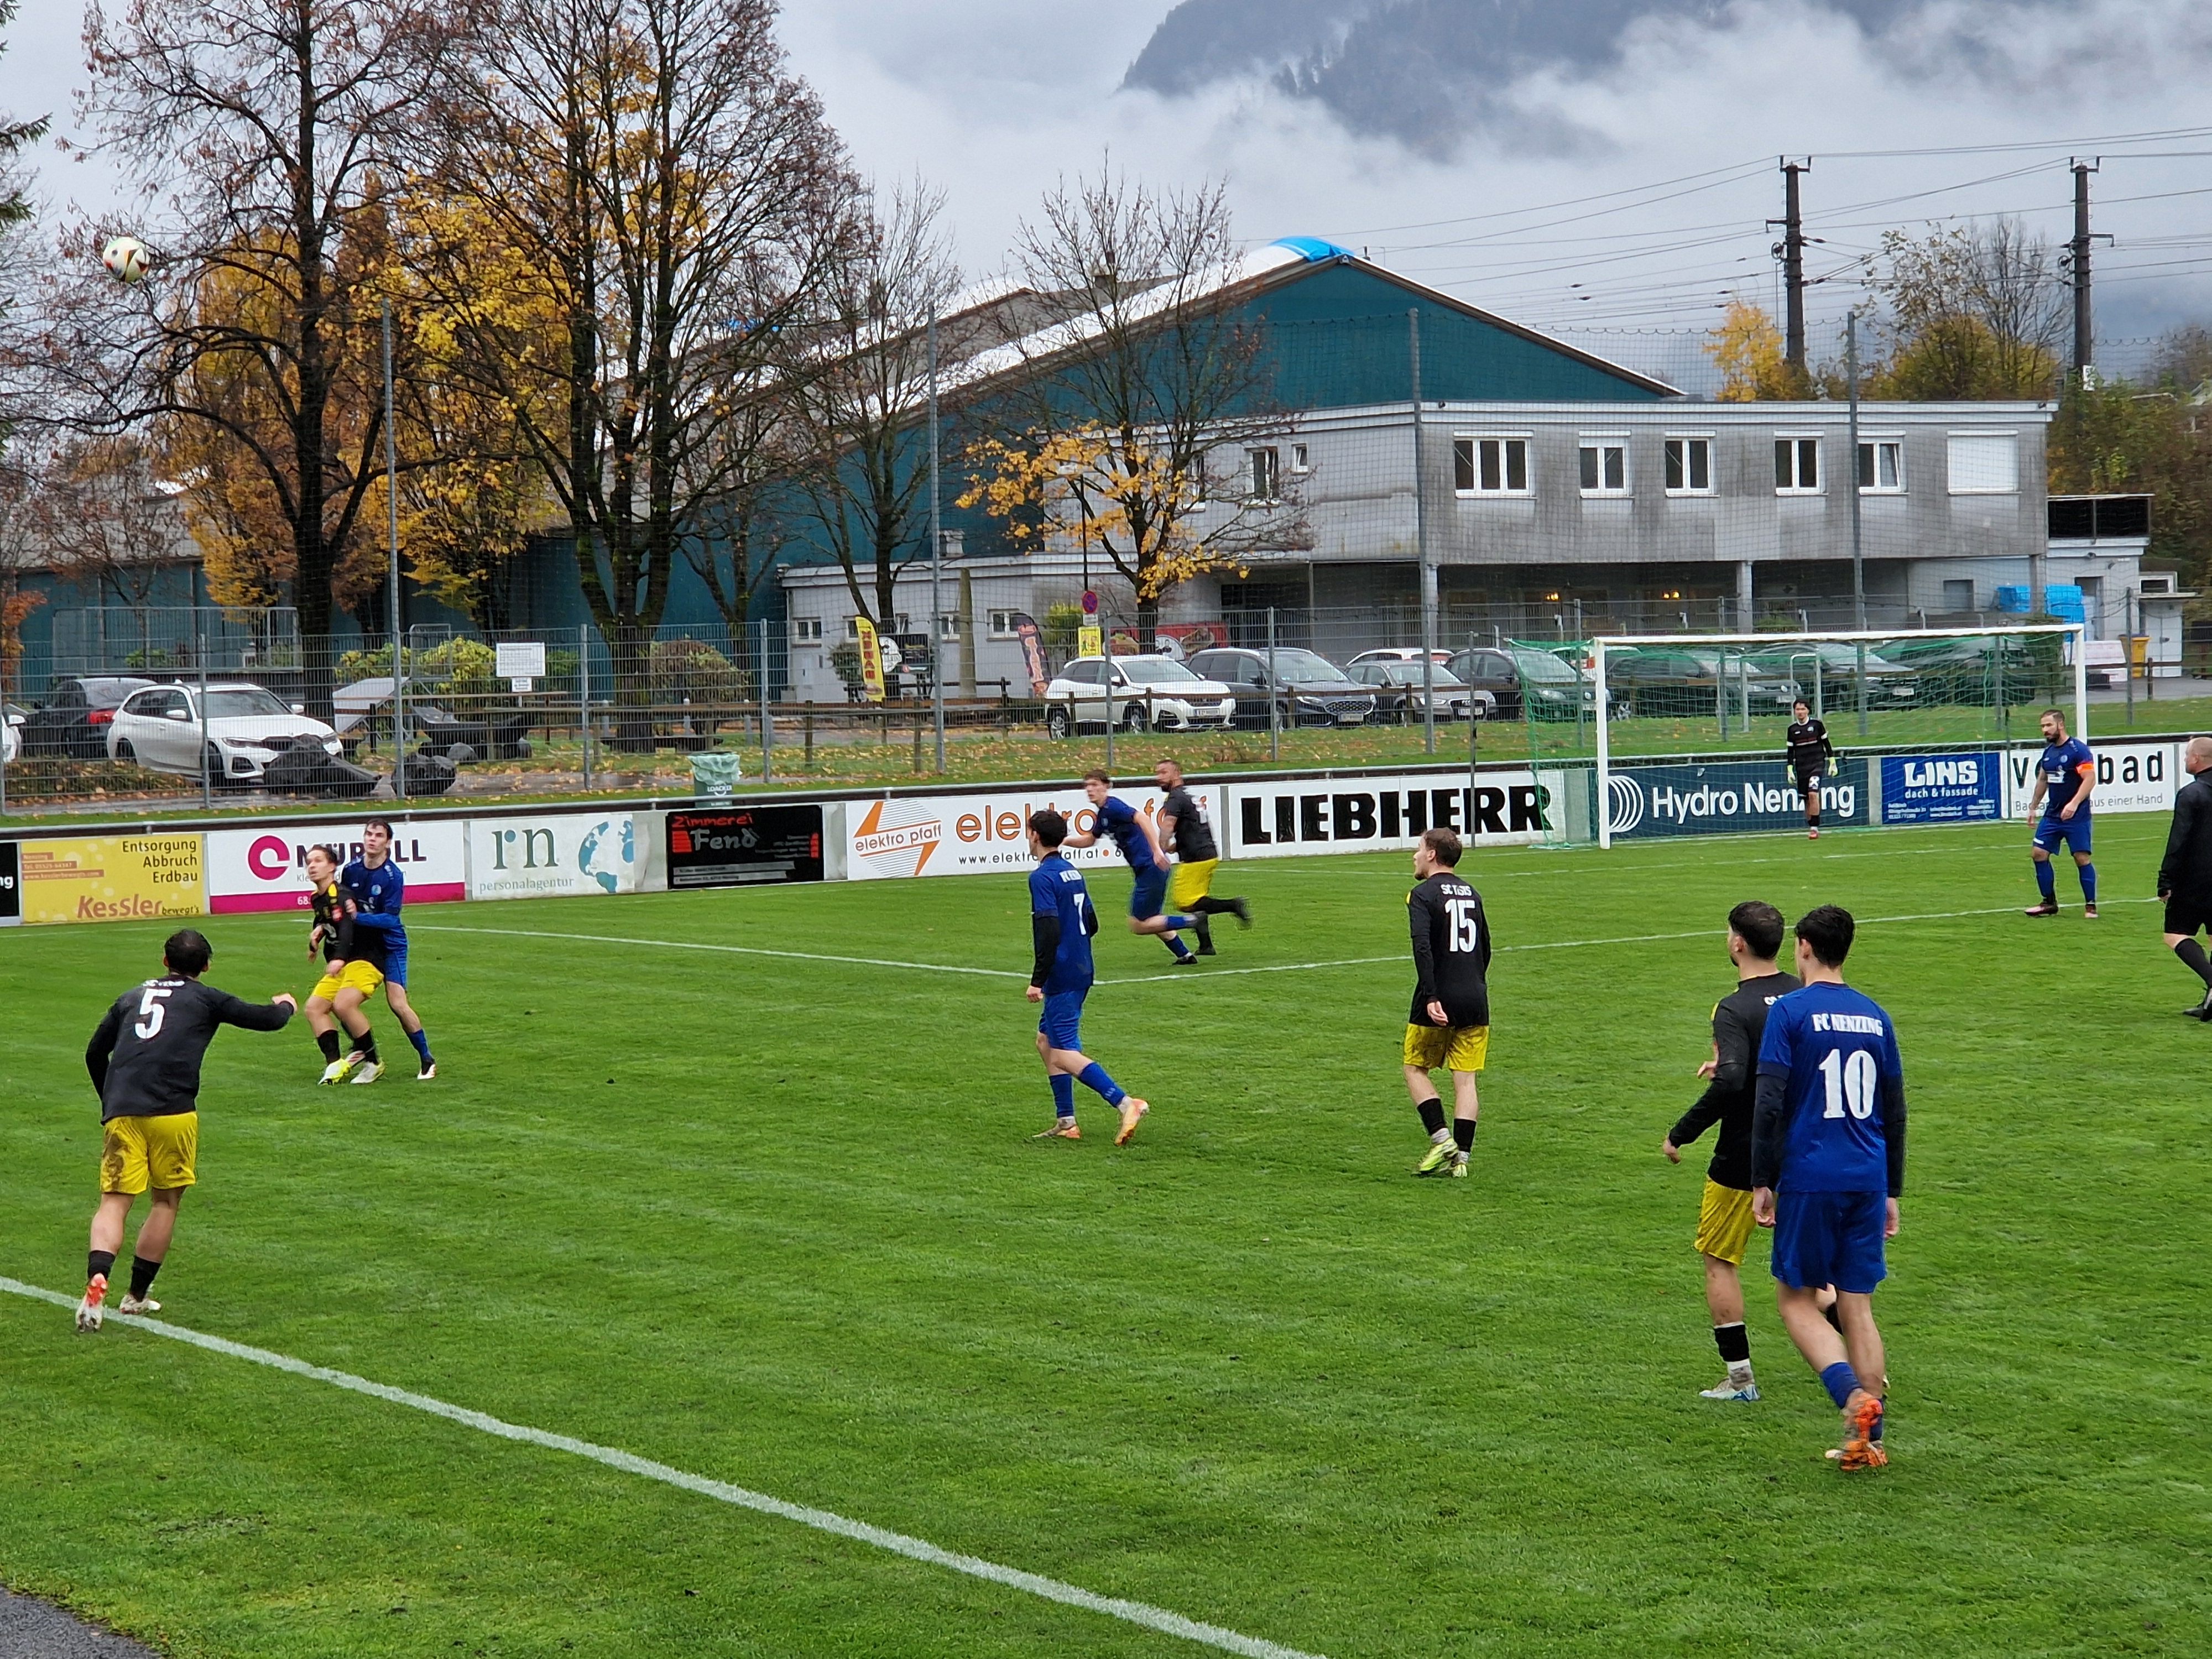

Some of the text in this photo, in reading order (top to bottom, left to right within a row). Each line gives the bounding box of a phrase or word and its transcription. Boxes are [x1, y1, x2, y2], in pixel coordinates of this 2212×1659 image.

[1905, 761, 1978, 787] LINS
[1653, 784, 1738, 824] Hydro
[1745, 781, 1855, 817] Nenng
[1905, 786, 1978, 799] dach & fassade
[2109, 796, 2133, 806] einer
[2137, 793, 2163, 805] Hand
[672, 813, 754, 827] Zimmerei
[1241, 785, 1554, 845] LIEBHERR
[122, 840, 196, 854] Entsorgung
[690, 828, 760, 851] Fend
[855, 823, 941, 852] elektro pfaff
[143, 853, 197, 868] Abbruch
[153, 870, 197, 883] Erdbau
[480, 877, 574, 894] personalagentur
[1073, 893, 1087, 935] 7
[1444, 899, 1477, 952] 15
[135, 988, 172, 1039] 5
[1811, 1013, 1884, 1037] FC NENZING
[1819, 1049, 1877, 1119] 10
